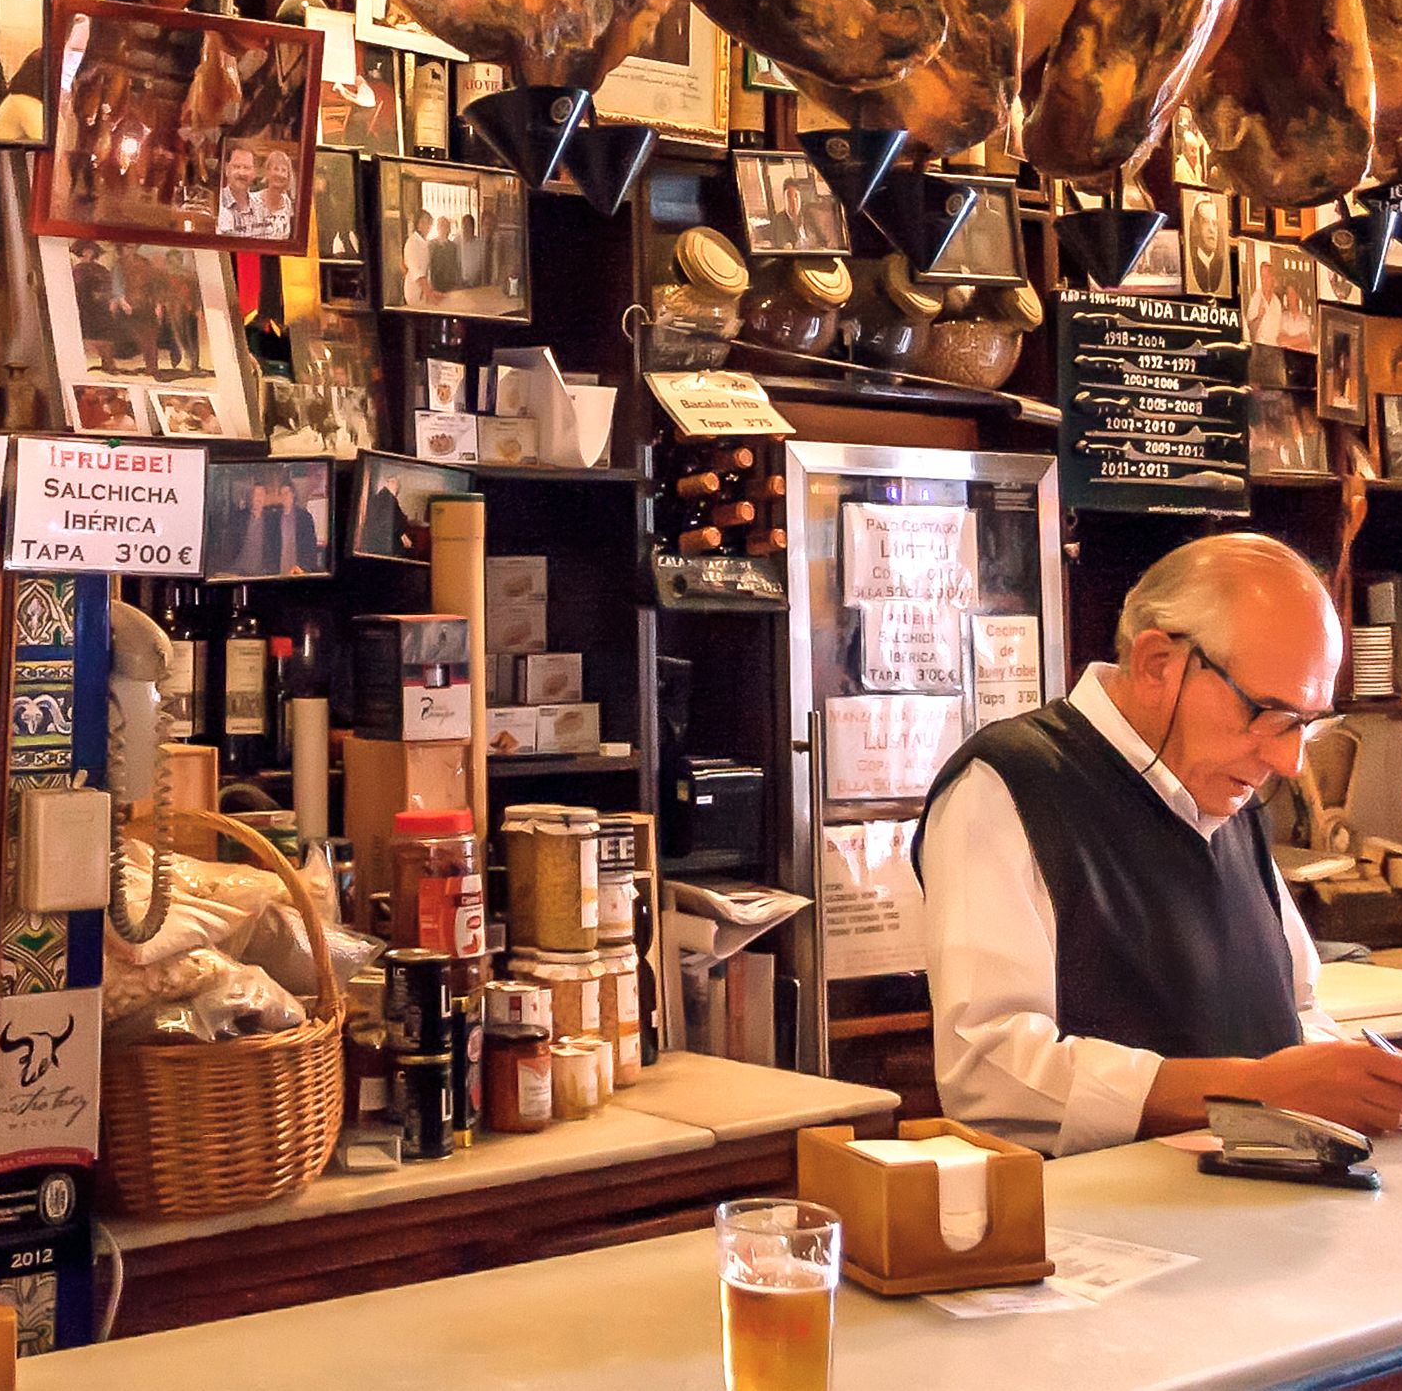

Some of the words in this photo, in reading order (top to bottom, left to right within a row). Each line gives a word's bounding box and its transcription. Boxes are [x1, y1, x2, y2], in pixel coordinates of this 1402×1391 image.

[1104, 332, 1166, 349] 1998-2004
[1123, 374, 1179, 390] 2003-2006
[679, 399, 729, 410] Bacalao
[731, 398, 759, 410] frito
[1139, 397, 1203, 415] 2005-2008
[699, 418, 732, 429] Tapa
[1106, 417, 1176, 433] 2007-2010
[1145, 441, 1205, 458] 2009-2012
[1101, 462, 1169, 477] 2011-2013
[43, 478, 179, 505] SALCHICHA
[63, 508, 156, 535] IBÉRICA
[20, 540, 85, 563] TAPA
[114, 543, 171, 565] 3'00
[178, 546, 193, 565] €
[986, 623, 1026, 637] Cecina
[999, 645, 1015, 658] de
[1008, 665, 1037, 679] Kobe
[10, 1248, 54, 1269] 2012
